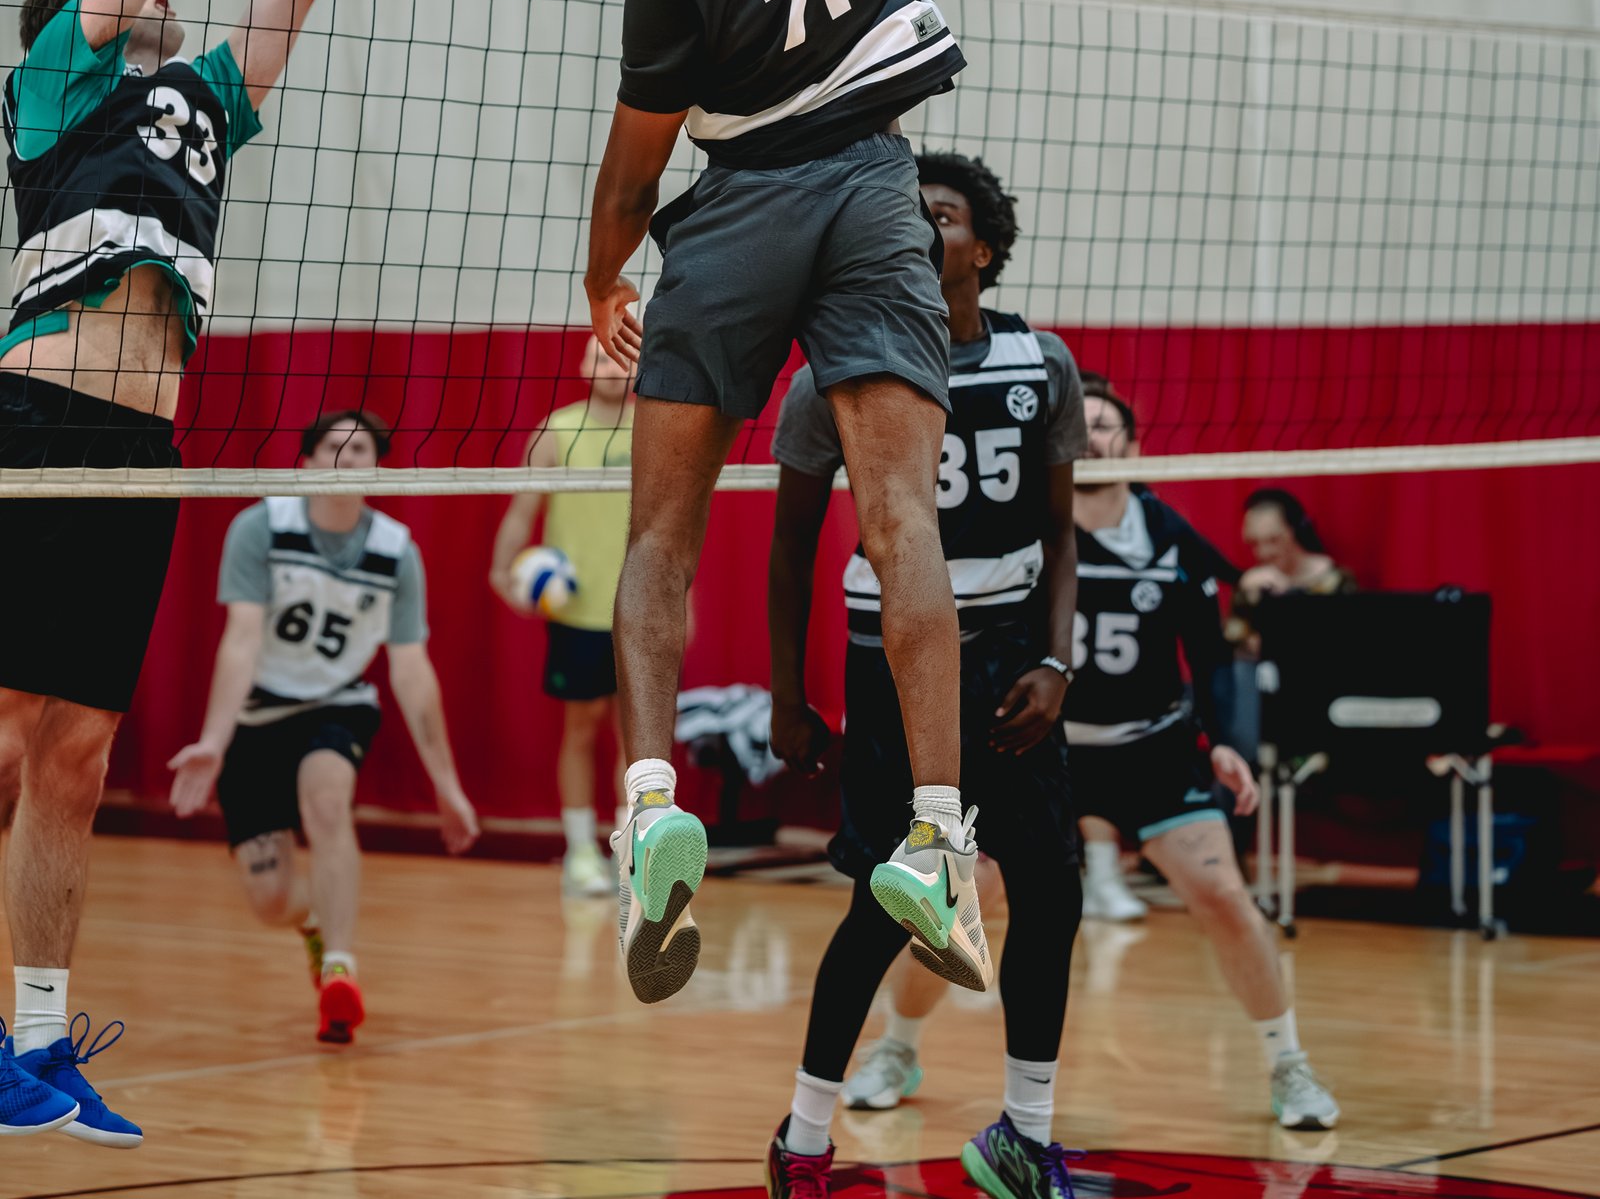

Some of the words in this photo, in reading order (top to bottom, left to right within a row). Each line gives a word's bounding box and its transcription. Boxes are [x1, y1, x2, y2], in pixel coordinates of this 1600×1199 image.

[136, 86, 218, 187] 33
[934, 426, 1022, 510] 35
[276, 601, 352, 660] 65
